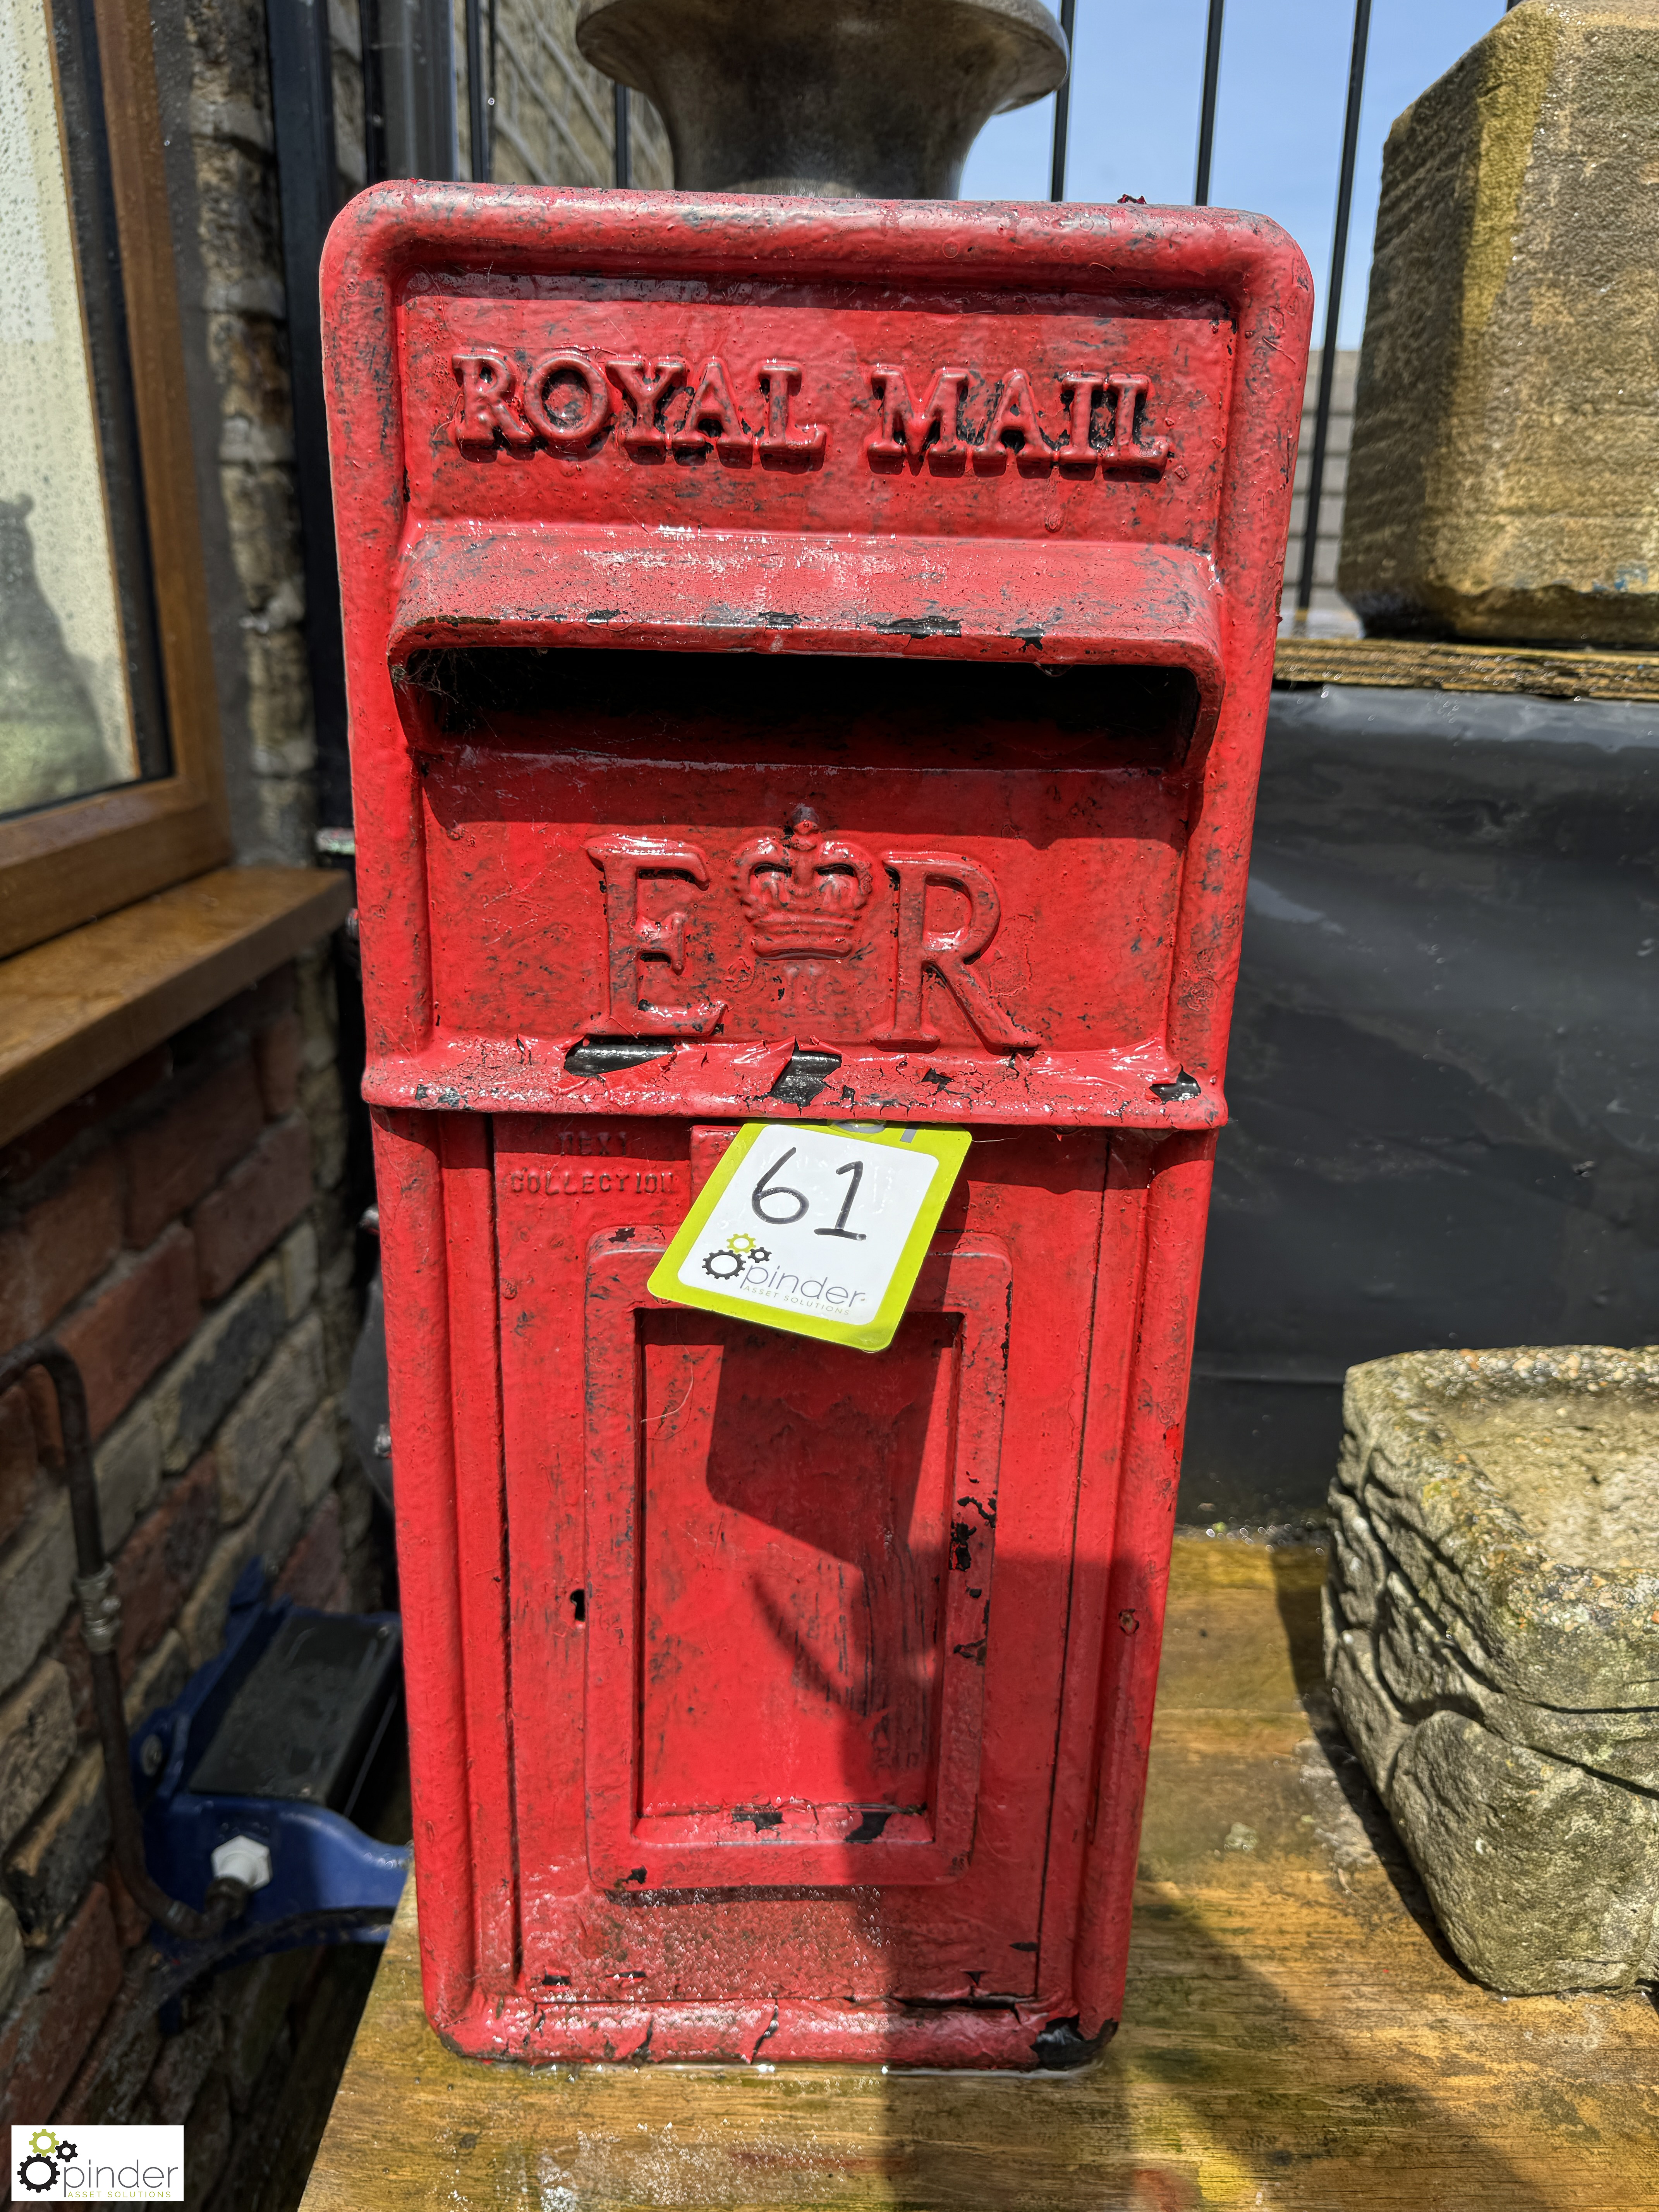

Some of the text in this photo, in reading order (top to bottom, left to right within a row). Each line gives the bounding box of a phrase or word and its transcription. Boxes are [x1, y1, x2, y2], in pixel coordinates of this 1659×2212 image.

[451, 349, 1169, 483] ROYAL MAIL
[586, 833, 728, 1039] E
[871, 852, 1041, 1055] R
[510, 1170, 675, 1195] COLLECTION
[751, 1147, 866, 1241] 61
[740, 1265, 866, 1307] pinder
[743, 1285, 850, 1315] ASSET SOLUTIONS
